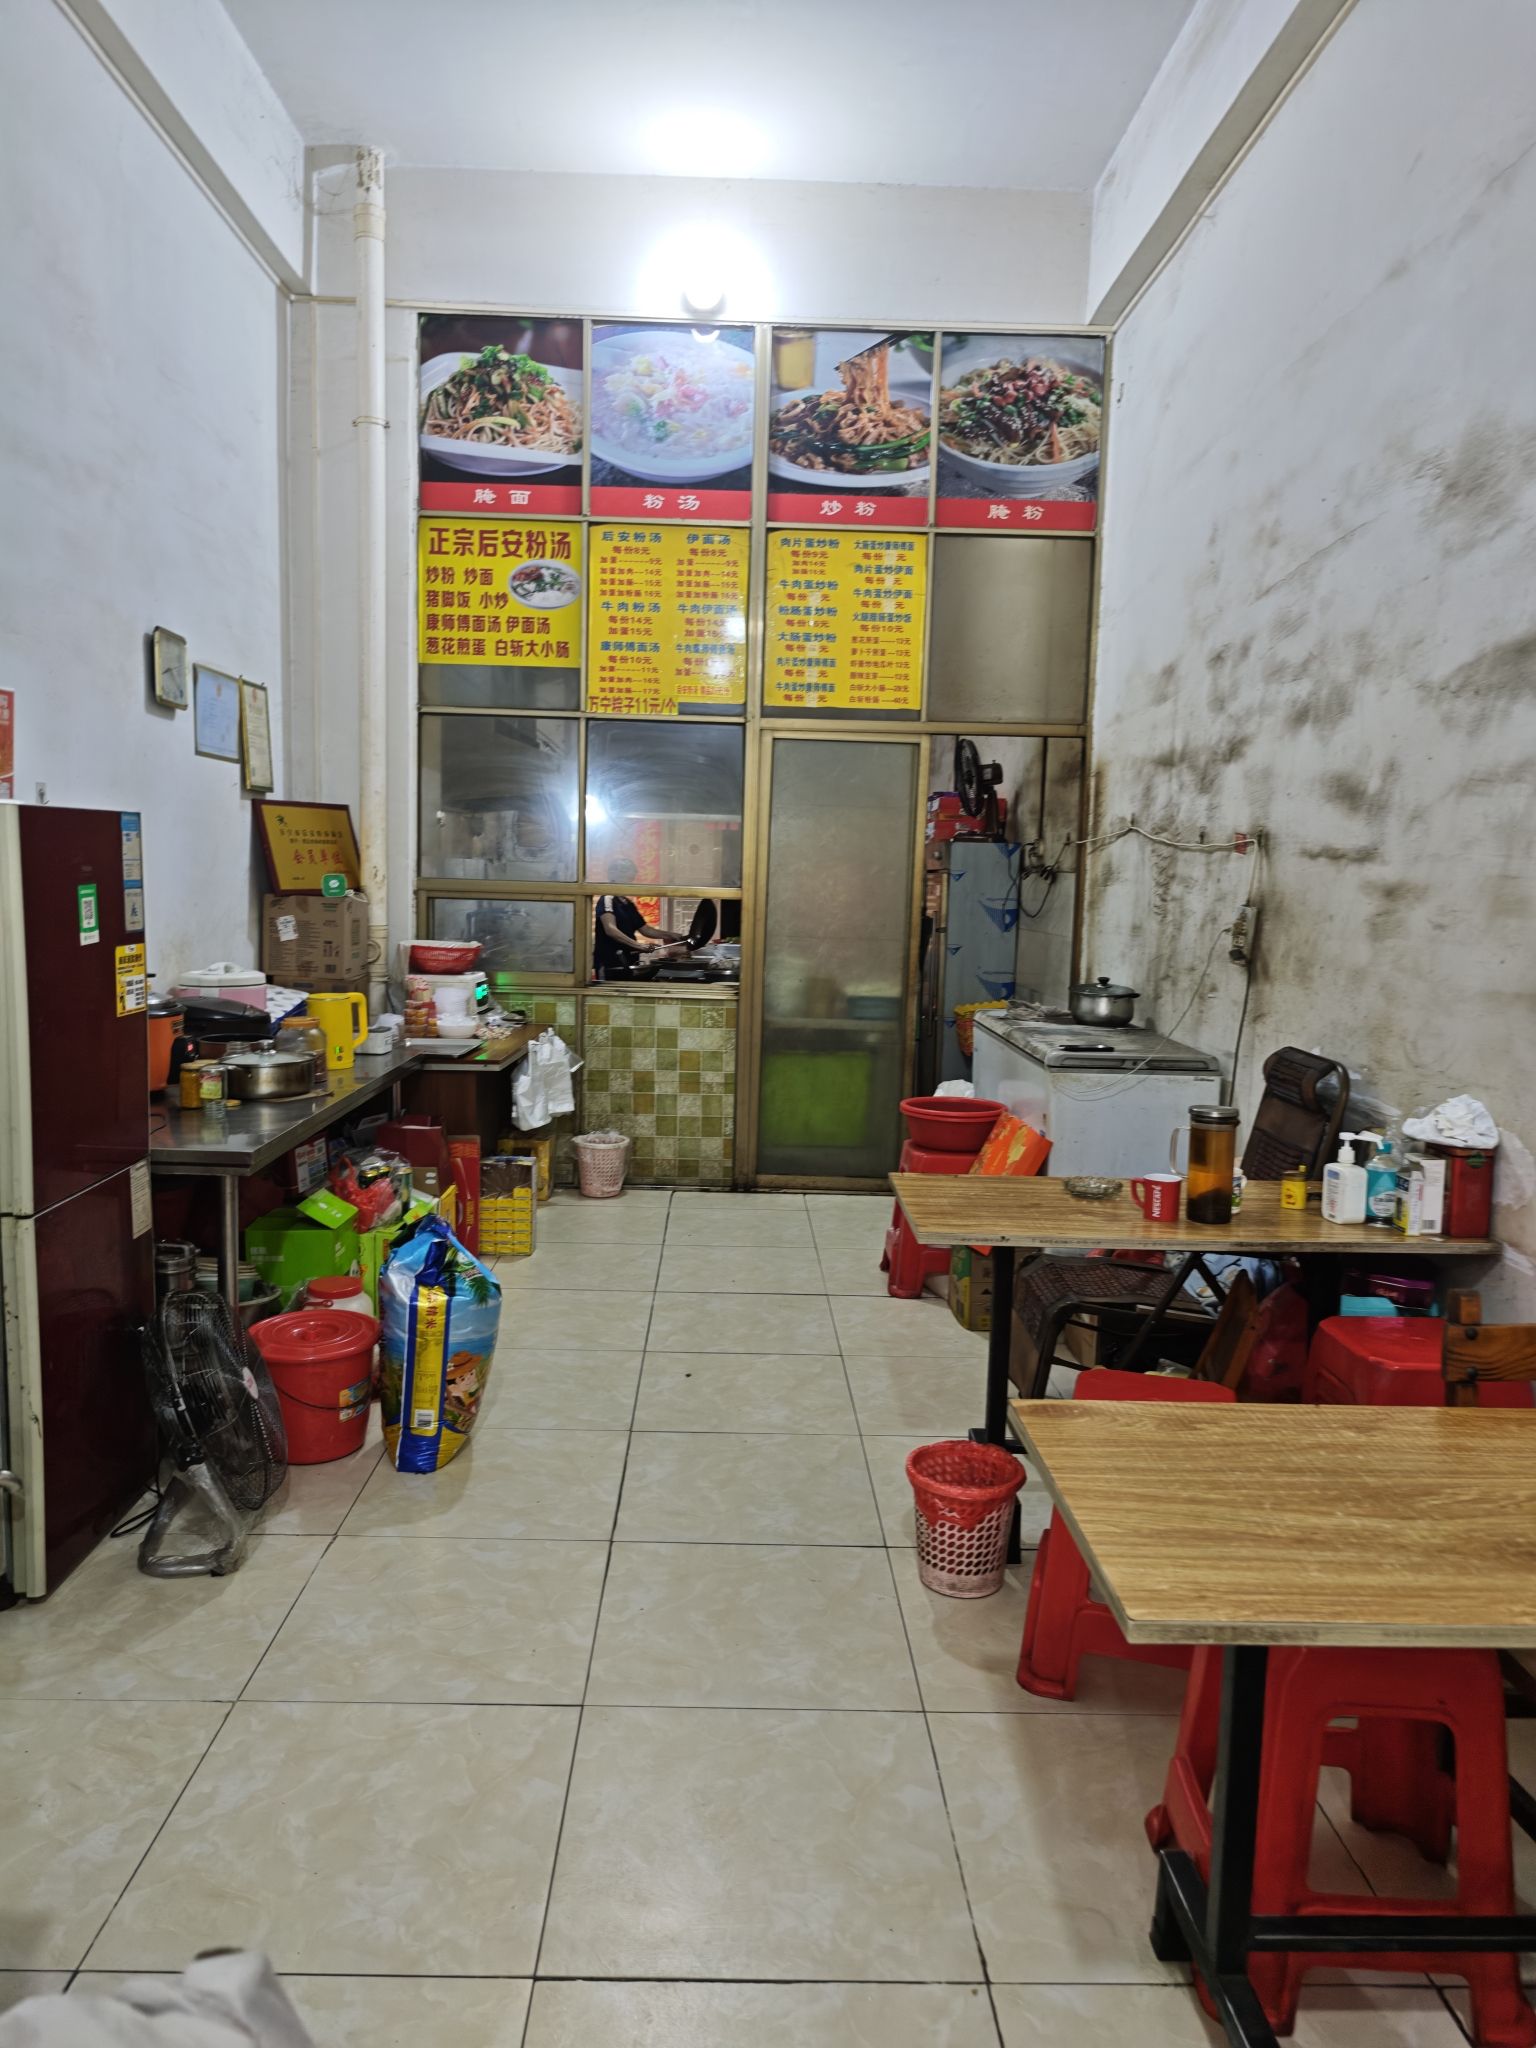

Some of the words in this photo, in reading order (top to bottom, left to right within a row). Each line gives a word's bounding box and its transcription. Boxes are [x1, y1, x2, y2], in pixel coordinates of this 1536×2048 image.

[474, 488, 531, 505] 腌面
[643, 494, 701, 511] 粉汤
[819, 500, 877, 516] 炒粉
[988, 505, 1045, 520] 腌粉
[429, 527, 571, 559] 正宗后安粉汤
[602, 531, 662, 543] 后安粉汤
[687, 534, 730, 544] 伊面汤
[781, 538, 839, 548] 肉片蛋炒粉
[426, 566, 455, 584] 炒粉
[464, 567, 493, 585] 炒面
[779, 579, 838, 590] 牛肉蛋炒粉
[426, 590, 470, 608] 猪脚饭
[479, 592, 509, 609] 小炒
[600, 601, 661, 613] 牛肉粉汤
[677, 604, 737, 614] 牛肉伊面汤
[426, 614, 501, 632] 康师傅面汤
[507, 616, 550, 634] 伊面汤
[608, 615, 653, 624] 每份14元
[426, 637, 486, 656] 葱花煎蛋
[495, 640, 570, 658] 白斩大小肠
[600, 641, 660, 652] 康师傅面汤
